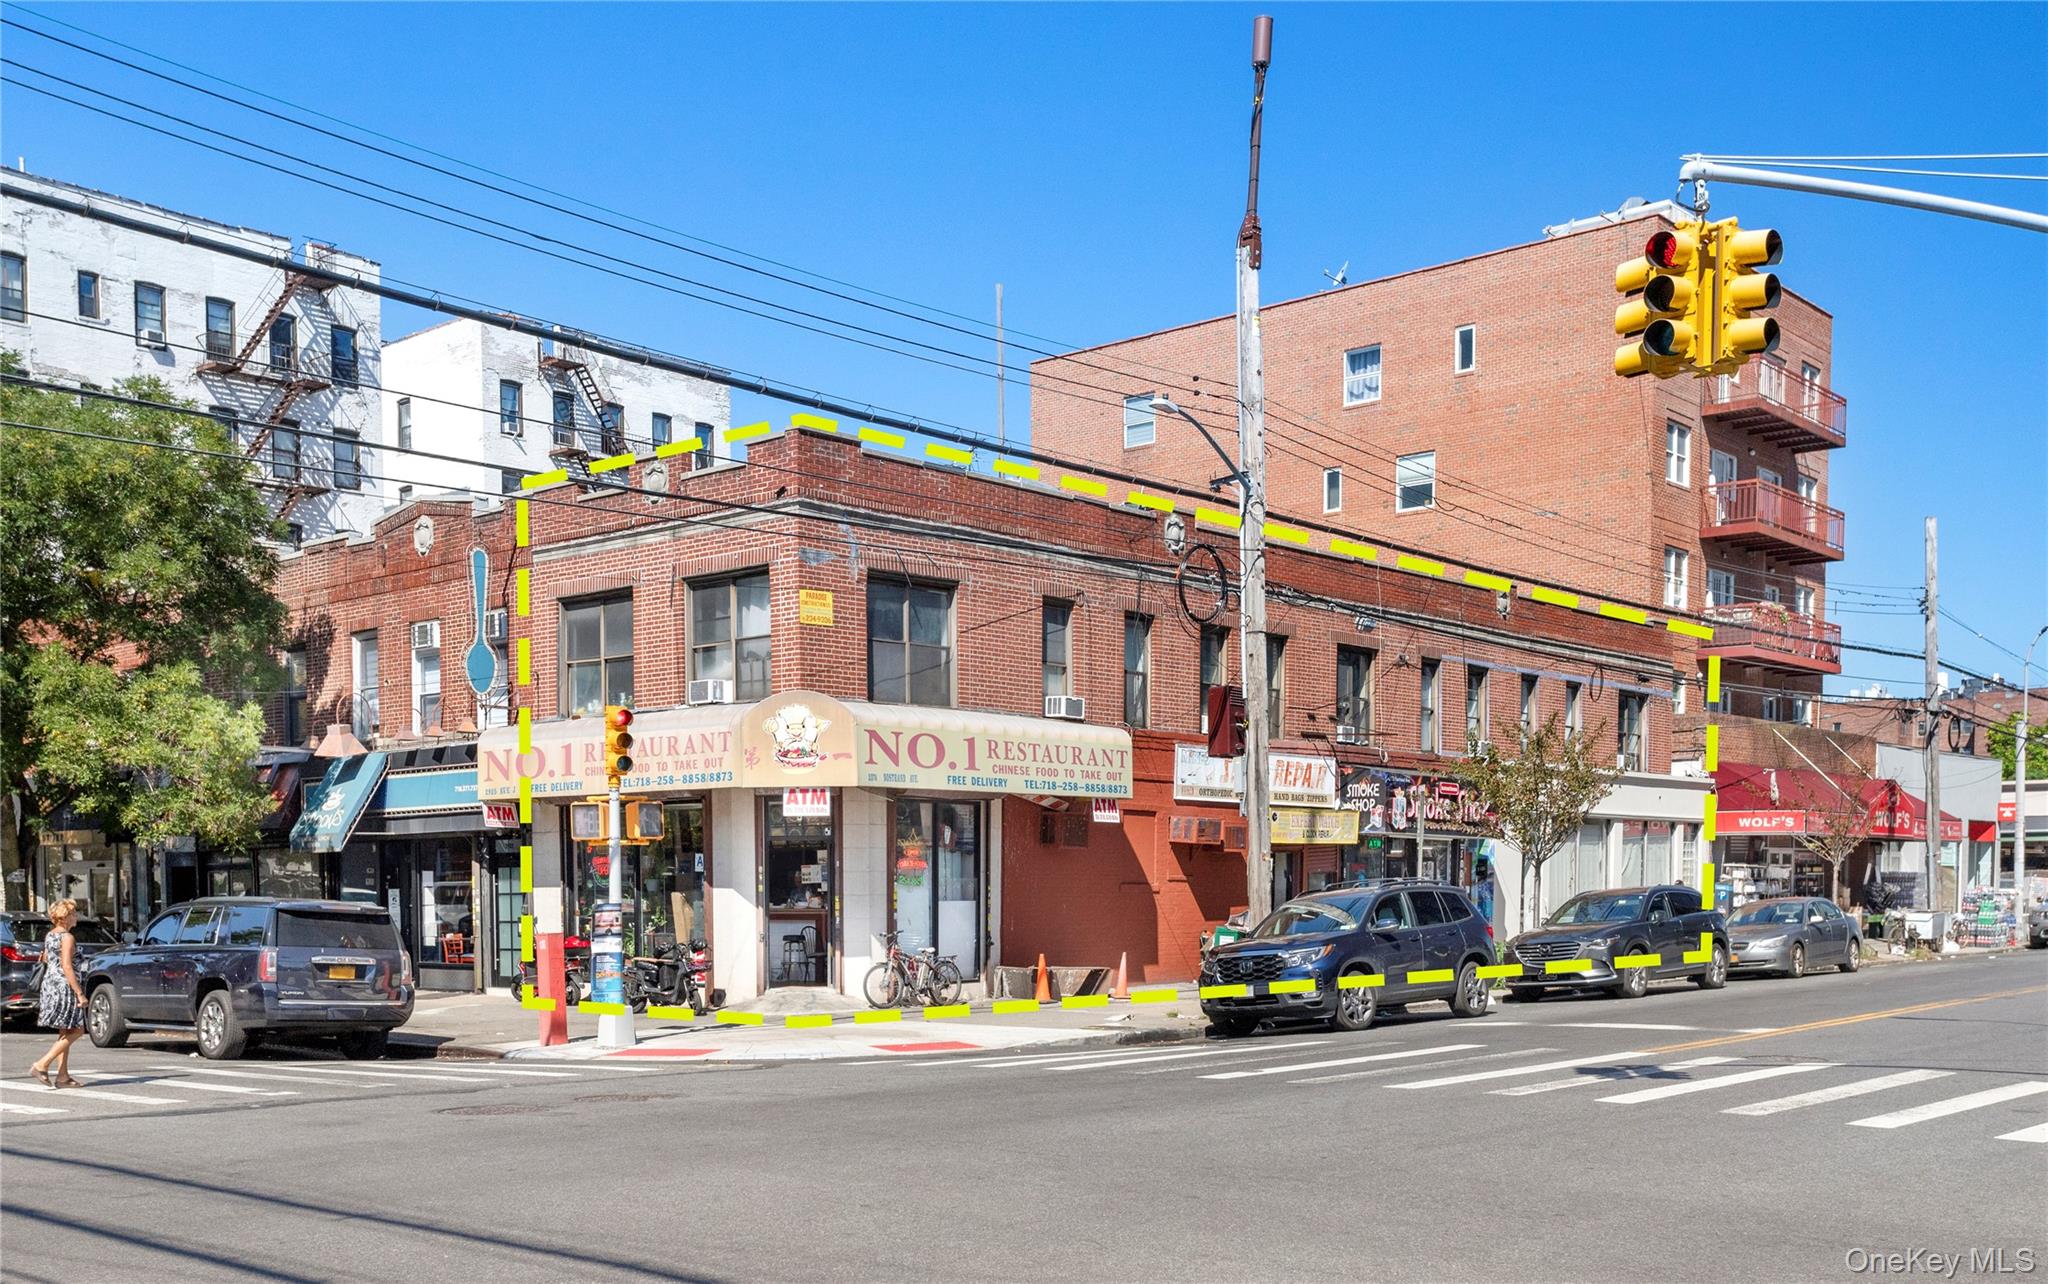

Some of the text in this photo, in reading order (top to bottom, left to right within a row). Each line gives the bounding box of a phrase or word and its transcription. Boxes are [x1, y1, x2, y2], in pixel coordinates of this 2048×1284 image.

[864, 729, 1128, 771] NO.1 RESTAURANT
[483, 742, 575, 782] NO.1
[656, 762, 668, 772] TO
[675, 759, 698, 771] TAKE
[704, 757, 723, 769] OUT
[992, 764, 1123, 782] CHINESE FOOD TO TAKE OUT
[530, 784, 547, 793] FREE
[550, 780, 583, 792] DELIVERY
[947, 775, 968, 786] FREE
[971, 777, 1008, 789] DELIVERY
[786, 788, 827, 806] ATM
[1273, 792, 1328, 803] HAND BAGS ZIPPERS
[1346, 783, 1380, 798] SMOKE
[1094, 799, 1118, 814] ATM
[1351, 798, 1376, 812] SHOP
[487, 806, 515, 821] ATM
[1875, 810, 1911, 830] WOLF'S
[1738, 815, 1795, 828] WOLF'S
[697, 856, 703, 866] A
